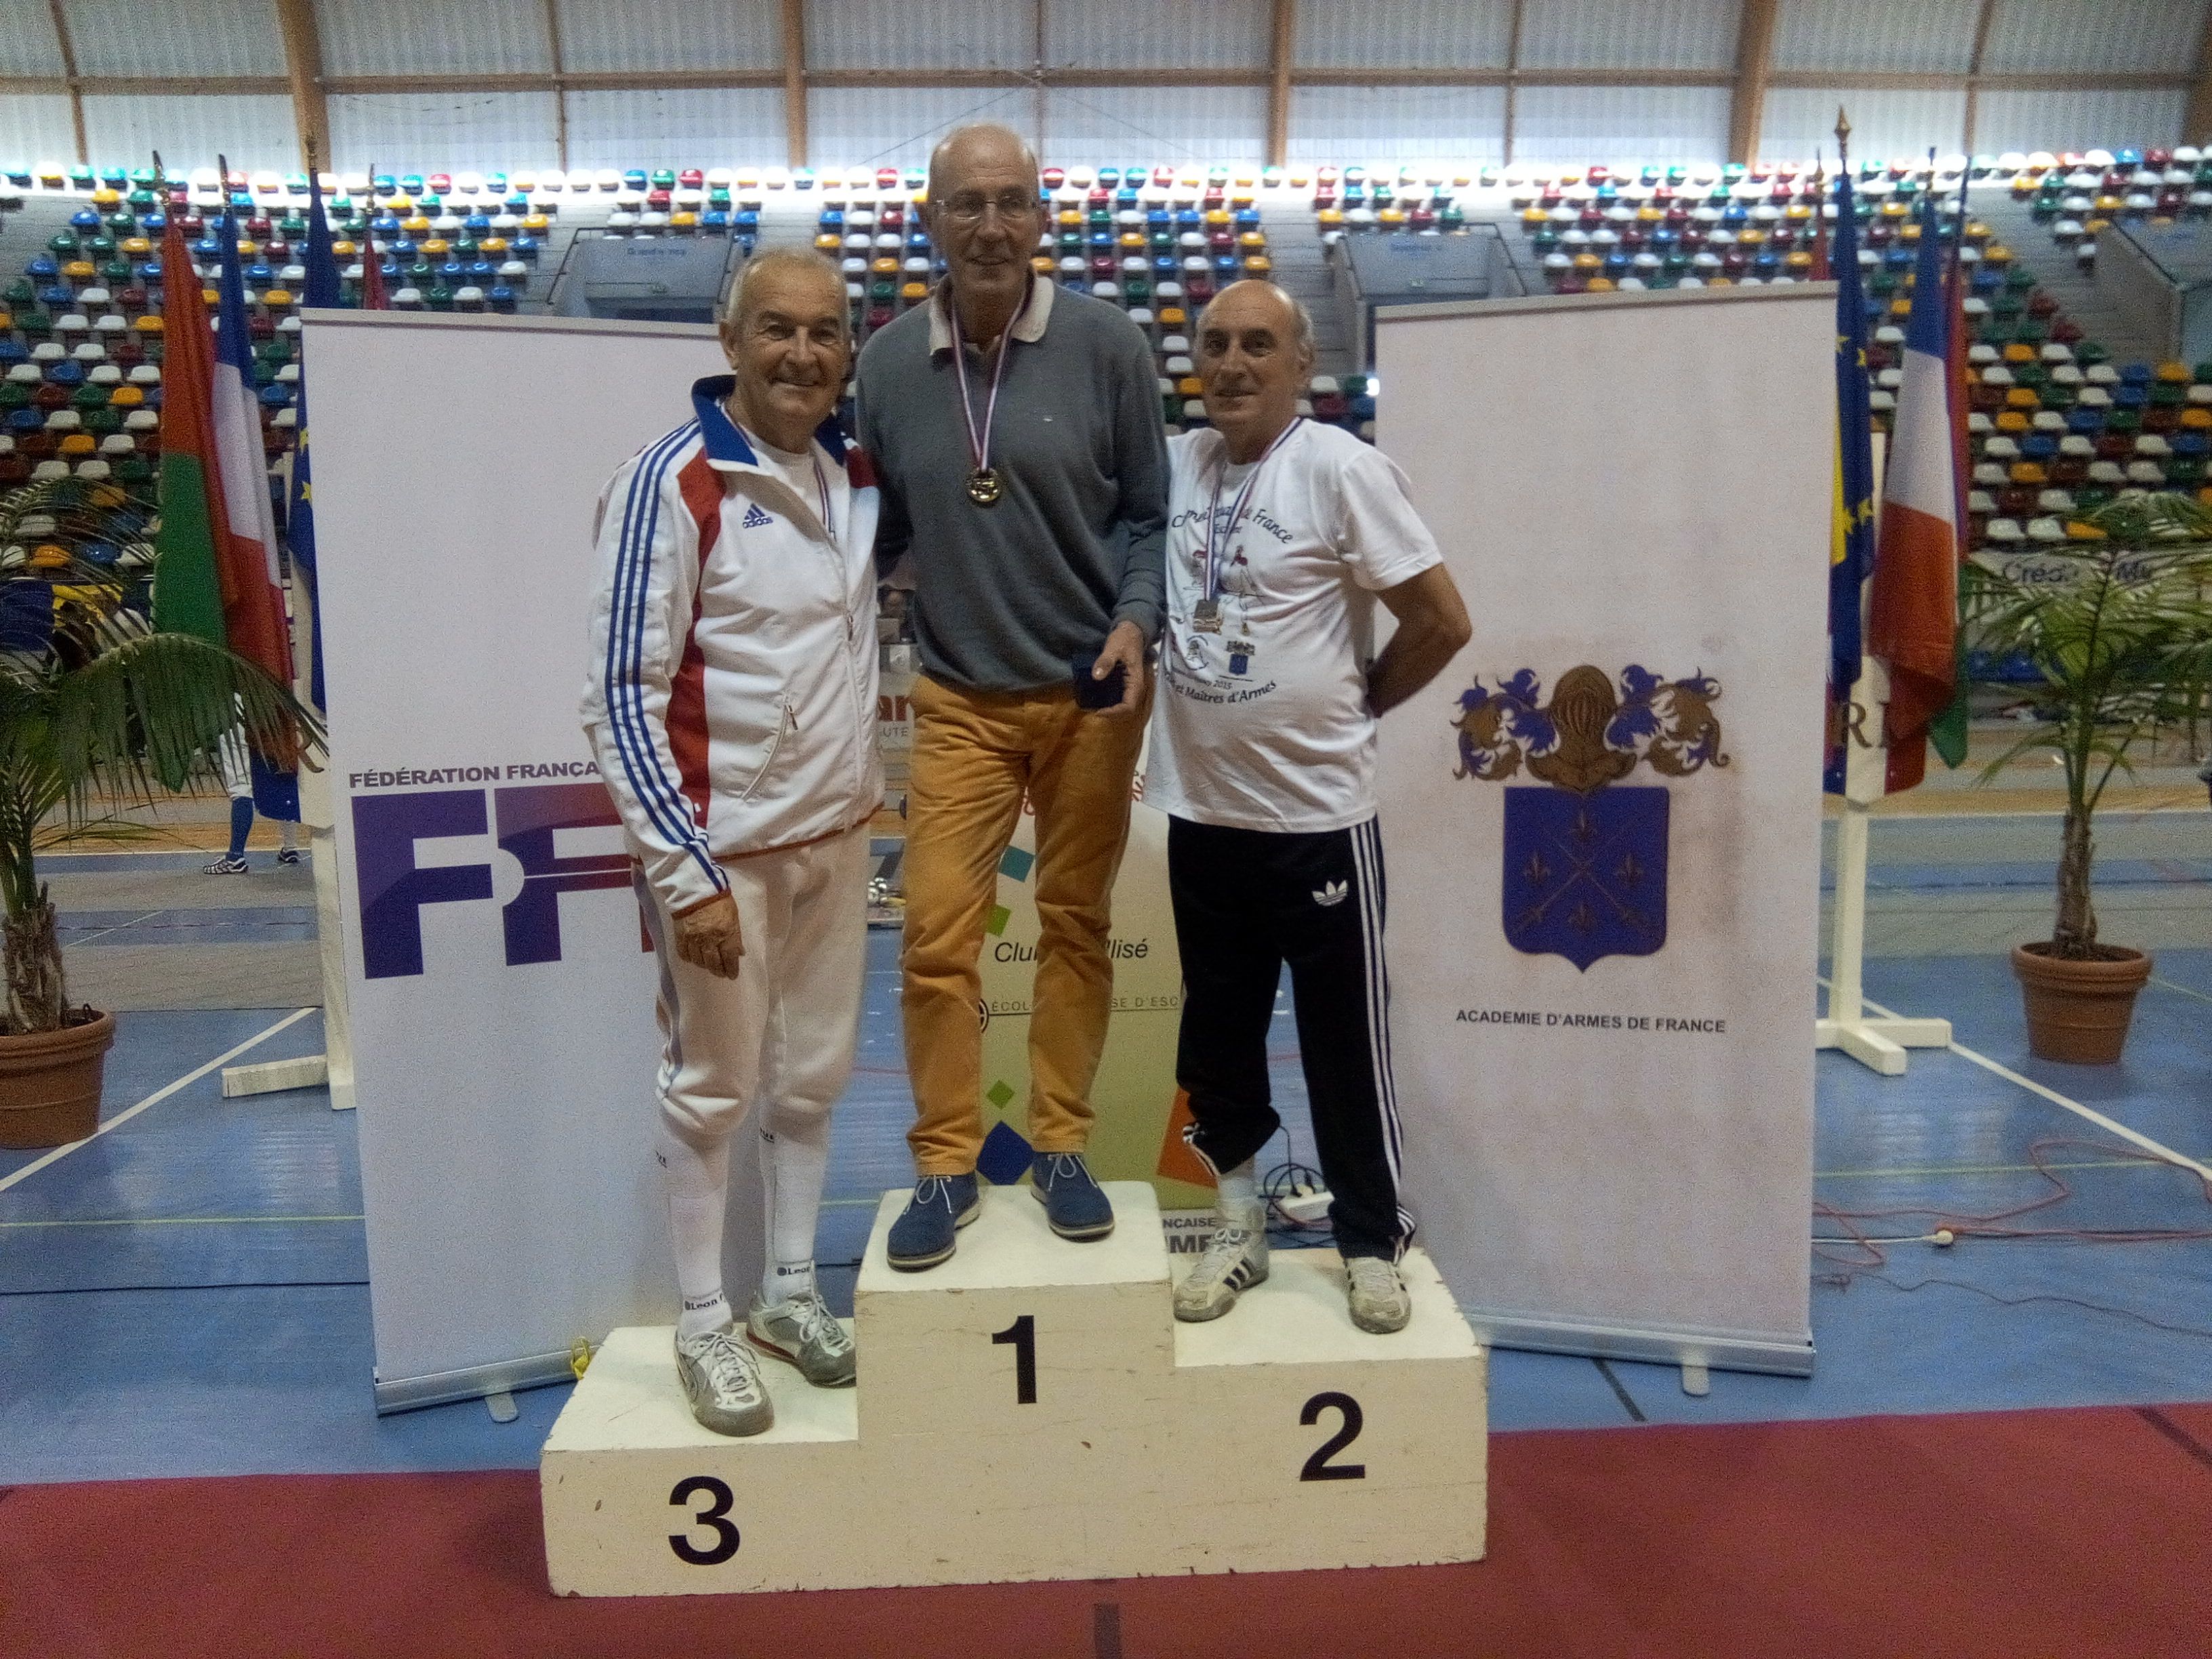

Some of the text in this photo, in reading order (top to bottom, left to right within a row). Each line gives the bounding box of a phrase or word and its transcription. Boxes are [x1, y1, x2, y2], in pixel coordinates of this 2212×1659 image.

[742, 516, 774, 529] adidas
[1252, 508, 1294, 544] France
[349, 760, 602, 789] FÉDÉRATION FRANÇA
[994, 941, 1037, 962] Clu
[991, 1000, 1033, 1012] ÉCOL
[1456, 1008, 1726, 1033] ACADEMIE D'ARMES DE FRANCE
[991, 1315, 1038, 1404] 1
[1299, 1391, 1366, 1482] 2
[668, 1475, 741, 1565] 3
